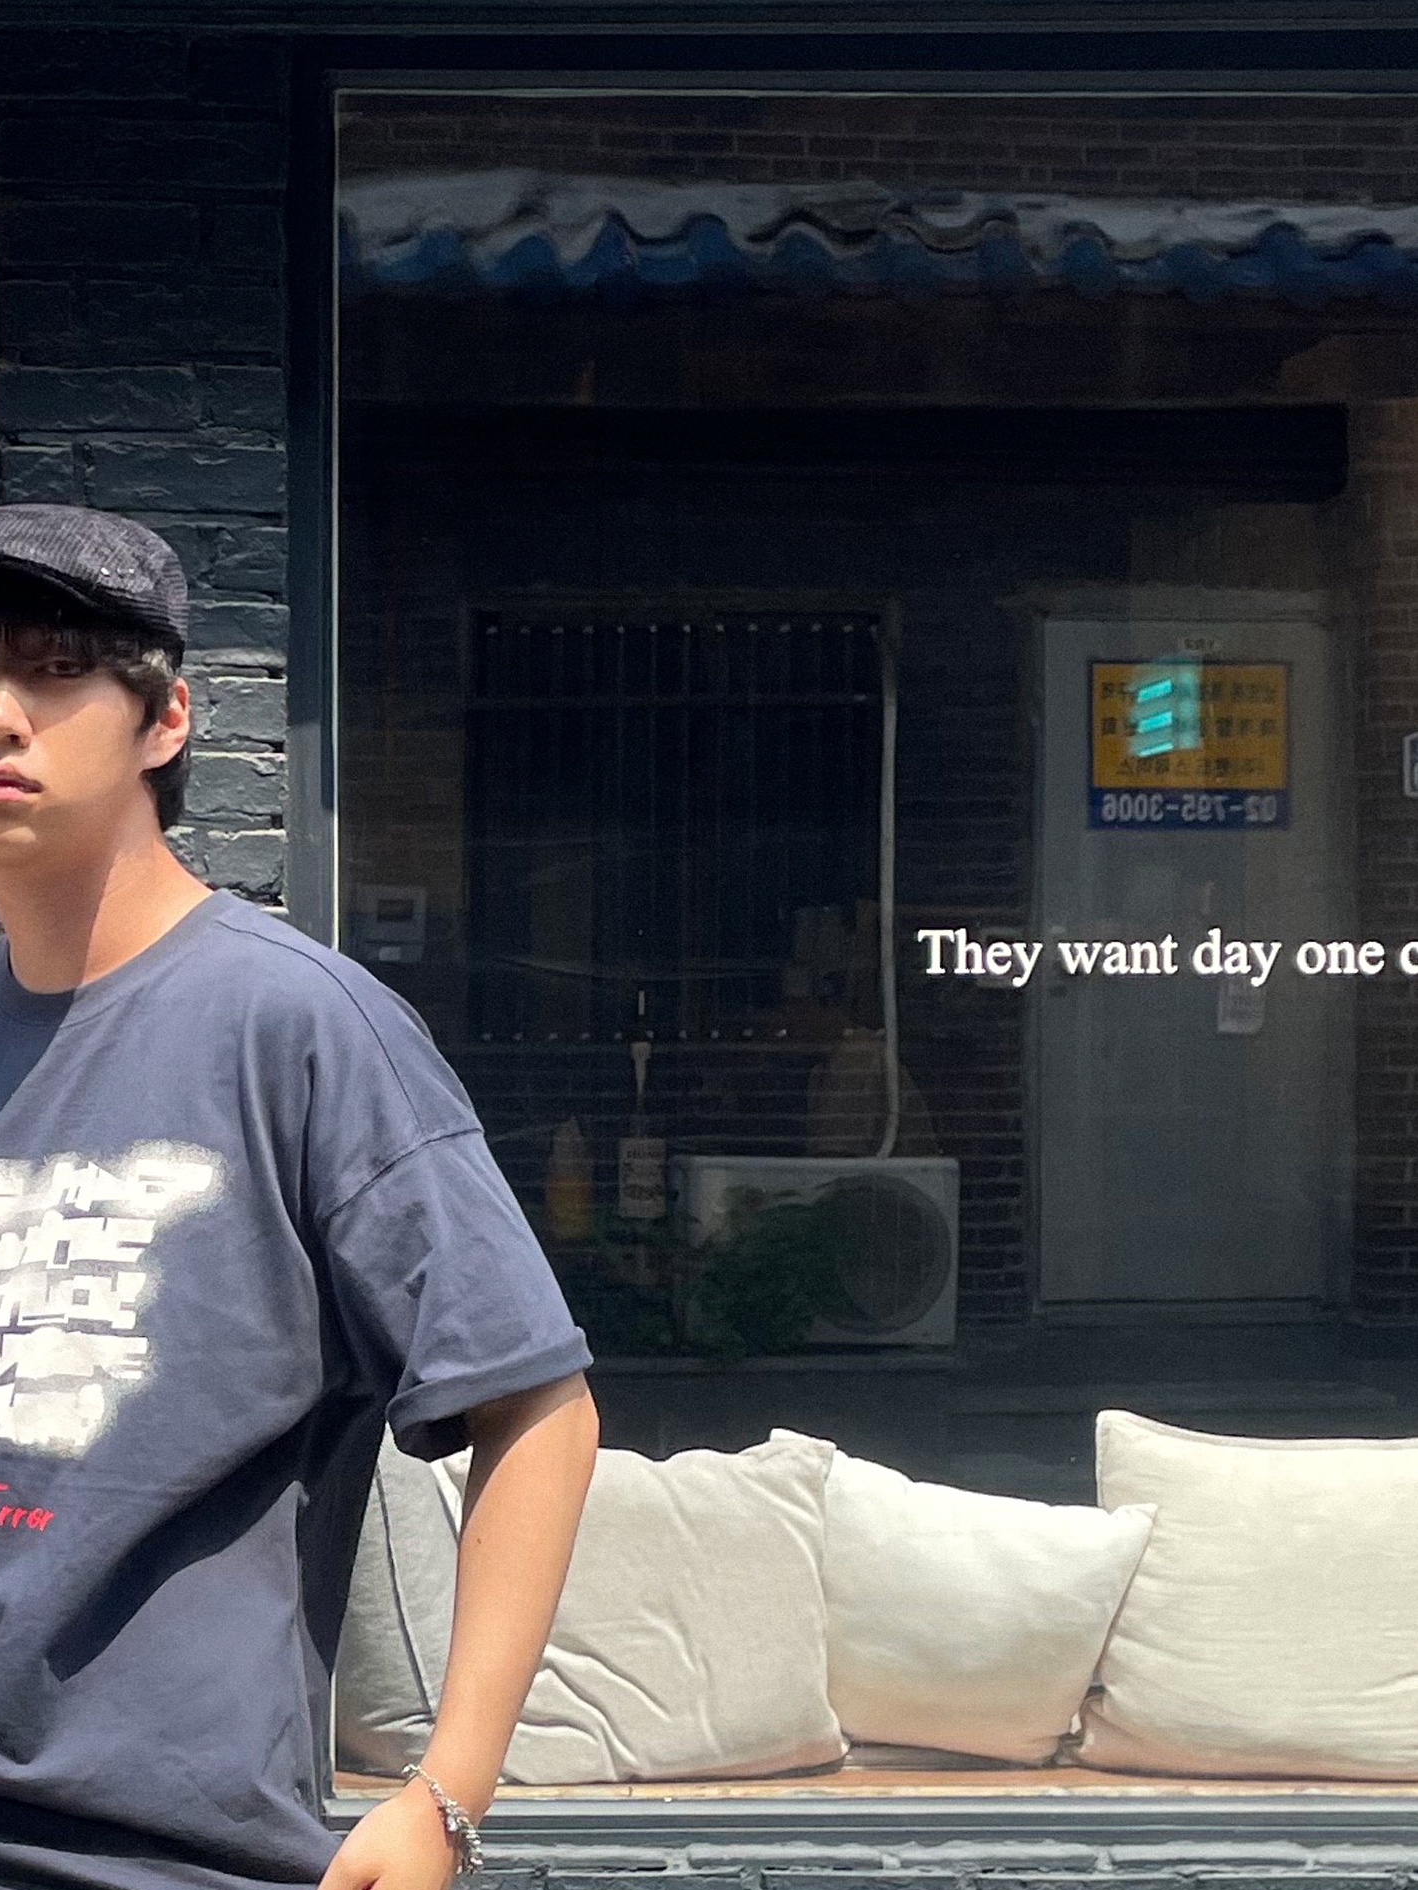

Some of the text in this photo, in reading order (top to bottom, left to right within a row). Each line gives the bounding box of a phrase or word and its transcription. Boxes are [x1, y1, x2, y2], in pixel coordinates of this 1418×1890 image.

[917, 928, 1043, 987] They
[1058, 933, 1179, 975] want
[1192, 928, 1282, 987] day
[1296, 940, 1385, 975] one
